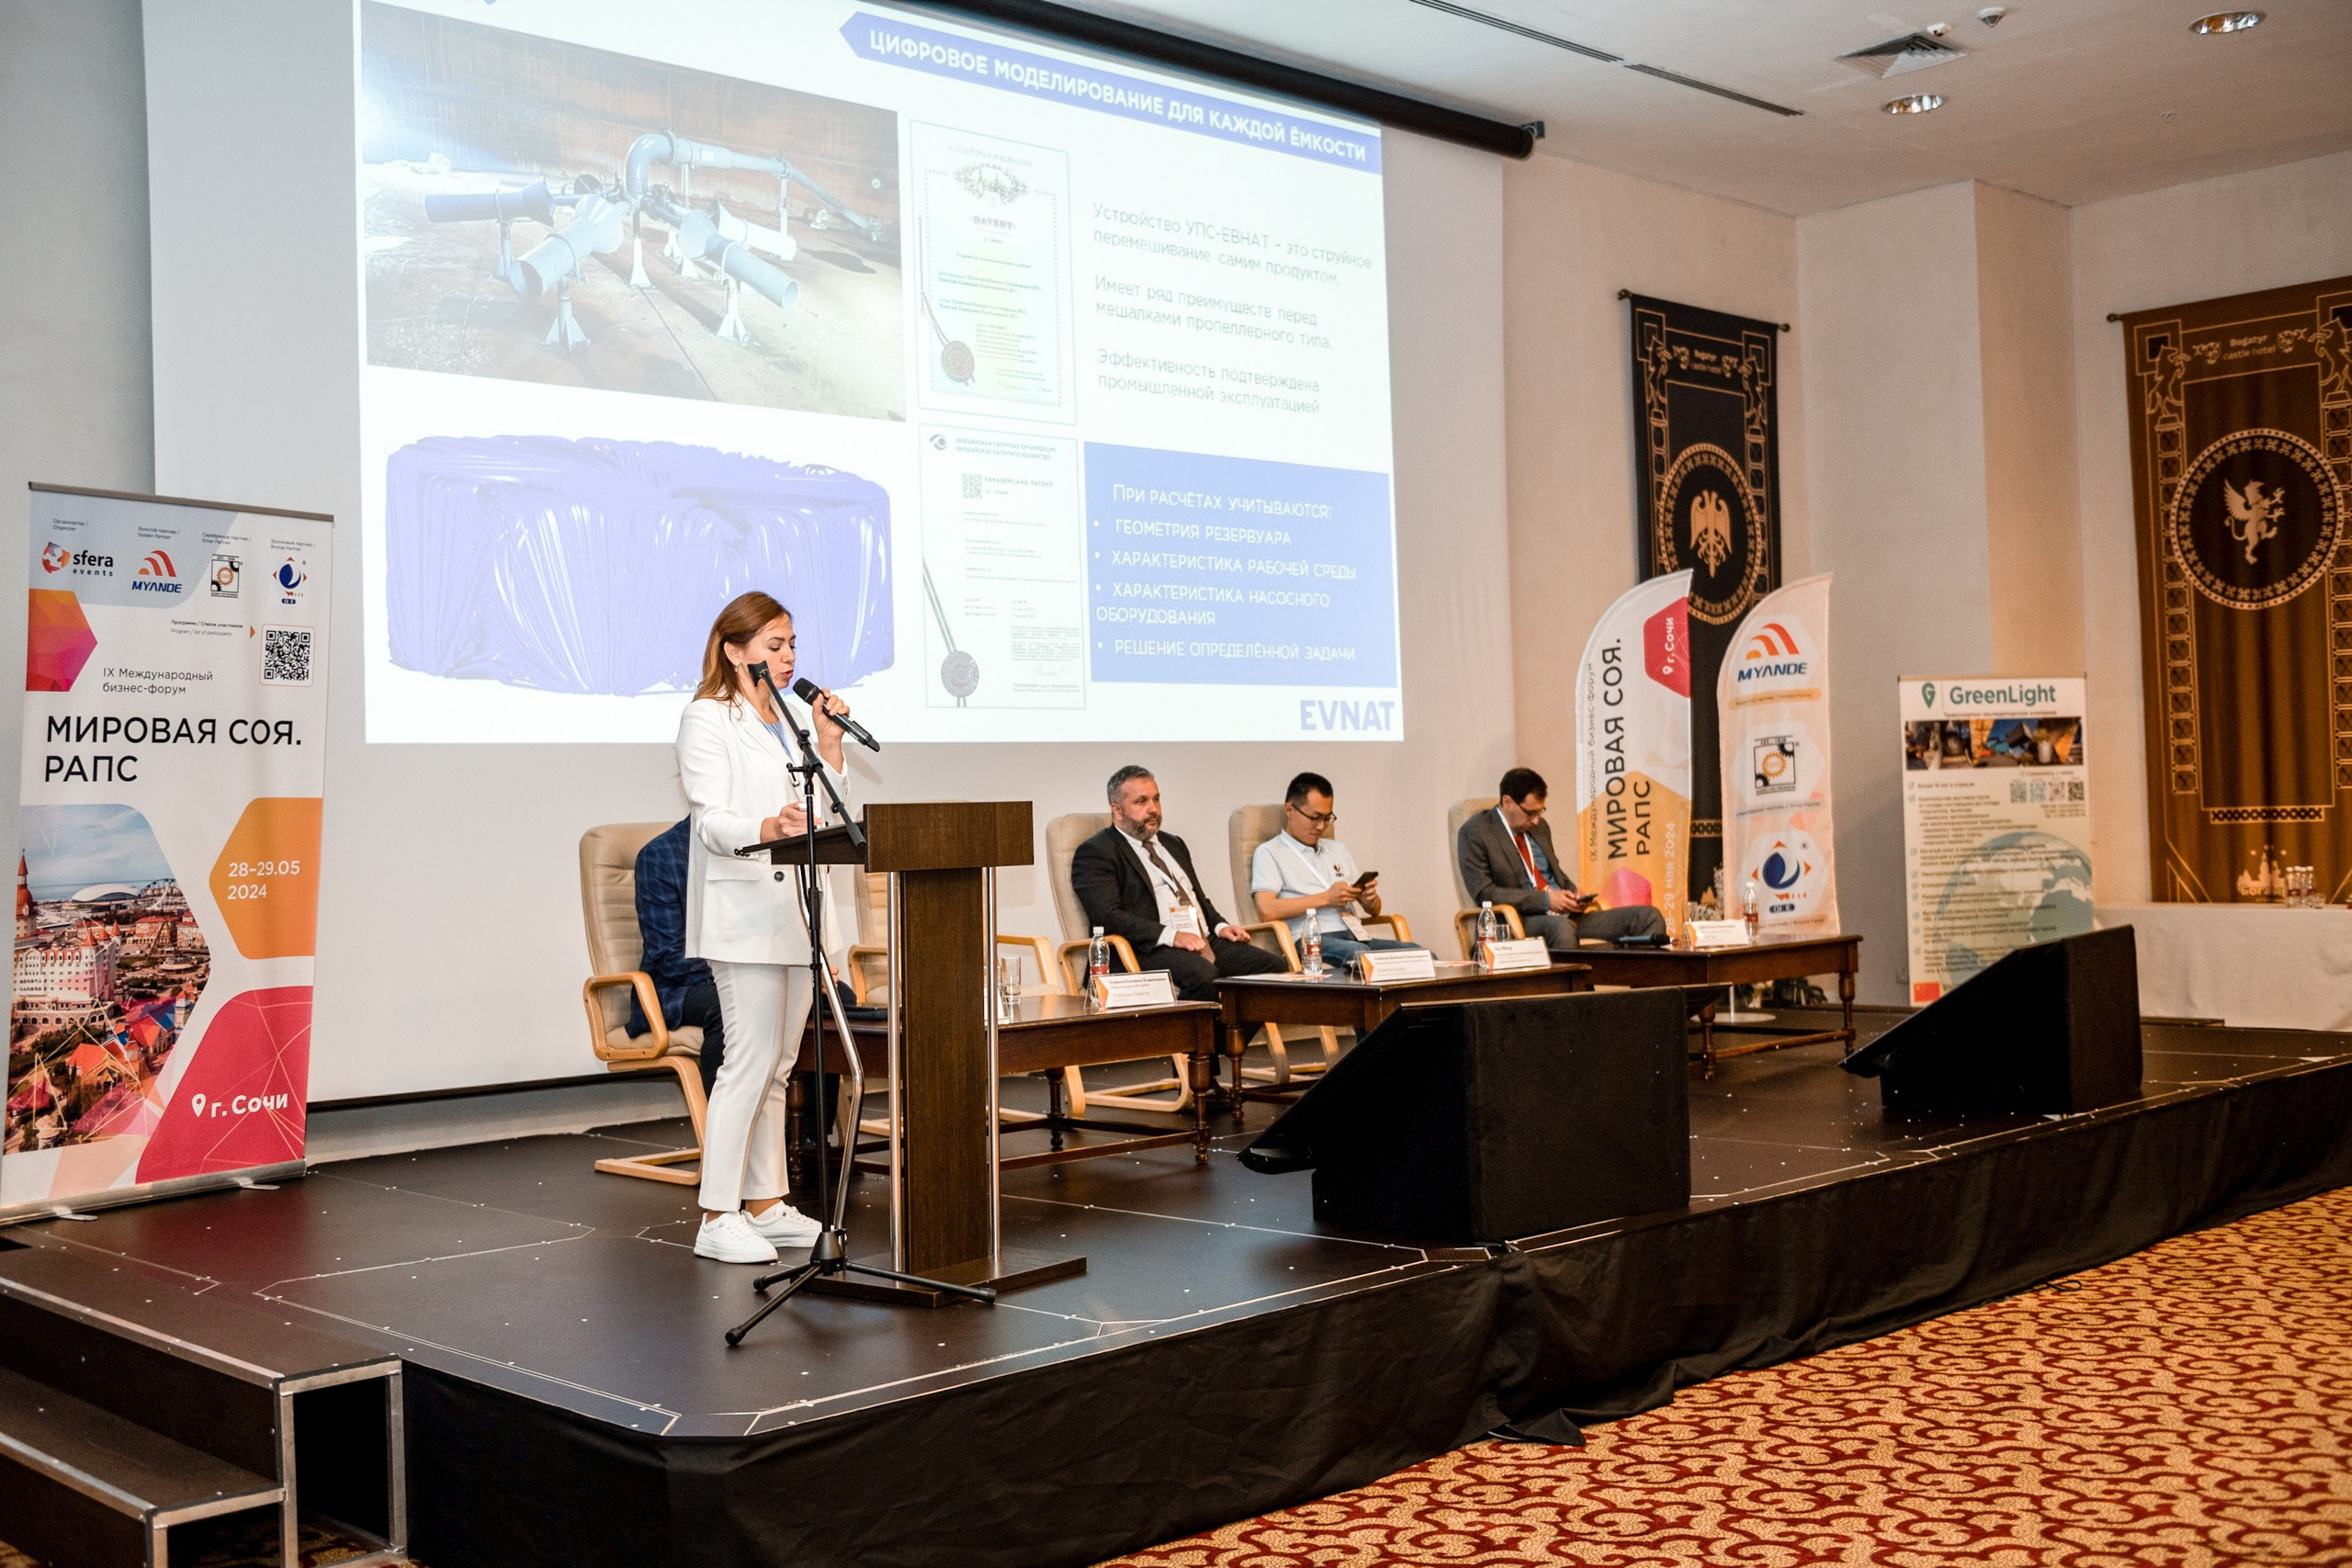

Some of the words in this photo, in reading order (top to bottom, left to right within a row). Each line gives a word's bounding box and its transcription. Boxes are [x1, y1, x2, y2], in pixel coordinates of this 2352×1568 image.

[869, 29, 989, 76] ЦИФРОВОЕ
[994, 59, 1164, 115] МОДЕЛИРОВАНИЕ
[1168, 101, 1204, 129] ДЛЯ
[1208, 107, 1286, 146] КАЖДОЙ
[1290, 126, 1367, 163] ЁМКОСТИ
[1093, 201, 1181, 233] Устройство
[1186, 220, 1270, 250] УПС-ЕВНАТ
[1285, 243, 1308, 257] это
[1312, 247, 1373, 269] струйное
[1093, 230, 1211, 262] перемешивание
[1218, 253, 1261, 271] самим
[1266, 261, 1341, 286] продуктом.
[1094, 275, 1140, 297] Имеет
[1147, 286, 1173, 303] ряд
[1179, 290, 1272, 319] преимуществ
[1278, 309, 1317, 327] перед
[1096, 302, 1181, 327] мешалками
[1187, 315, 1295, 344] пропеллерного
[1300, 333, 1333, 350] типа.
[2230, 334, 2268, 347] Bogatyr
[1098, 348, 1216, 380] Эффективность
[1222, 367, 1320, 393] подтверждена
[1099, 374, 1214, 401] промышленной
[1220, 389, 1320, 414] эксплуатацией
[1115, 518, 1200, 540] ГЕОМЕТРИЯ
[1205, 525, 1292, 547] РЕЗЕРВУАРА
[73, 550, 114, 568] sfera
[1112, 549, 1243, 572] ХАРАКТЕРИСТИКА
[1248, 557, 1309, 578] РАБОЧЕЙ
[1314, 562, 1357, 581] СРЕДЫ
[131, 581, 183, 593] MYANDE
[1113, 581, 1244, 604] ХАРАКТЕРИСТИКА
[1249, 589, 1330, 608] НАСОСНОГО
[1096, 606, 1216, 627] ОБОРУДОВАНИЯ
[1665, 616, 1675, 651] Сочи
[1114, 639, 1185, 657] РЕШЕНИЕ
[1189, 640, 1300, 661] ОПРЕДЕЛЁННОЙ
[1305, 644, 1356, 662] ЗАДАЧИ
[1667, 652, 1675, 664] г.
[104, 668, 115, 677] IX
[119, 668, 213, 682] Международный
[1602, 638, 1623, 706] СОЯ.
[1737, 662, 1808, 682] MYANDE
[103, 682, 186, 695] бизнес-форум
[1950, 683, 2056, 707] GreenLight
[1299, 699, 1396, 731] EVNAT
[1588, 663, 1596, 747] бизнес-форум
[47, 716, 216, 744] МИРОВАЯ
[229, 718, 301, 746] СОЯ.
[45, 754, 139, 783] РАПС
[1589, 748, 1597, 852] Международный
[1604, 716, 1628, 861] МИРОВАЯ
[1634, 781, 1651, 856] РАПС
[1665, 822, 1675, 857] 2024
[228, 860, 300, 878] 28-29.05
[1589, 852, 1598, 862] IX
[1666, 862, 1674, 888] мая
[227, 884, 267, 900] 2024
[1664, 892, 1676, 934] 28-29
[210, 1103, 228, 1118] г.
[232, 1092, 288, 1115] Сочи
